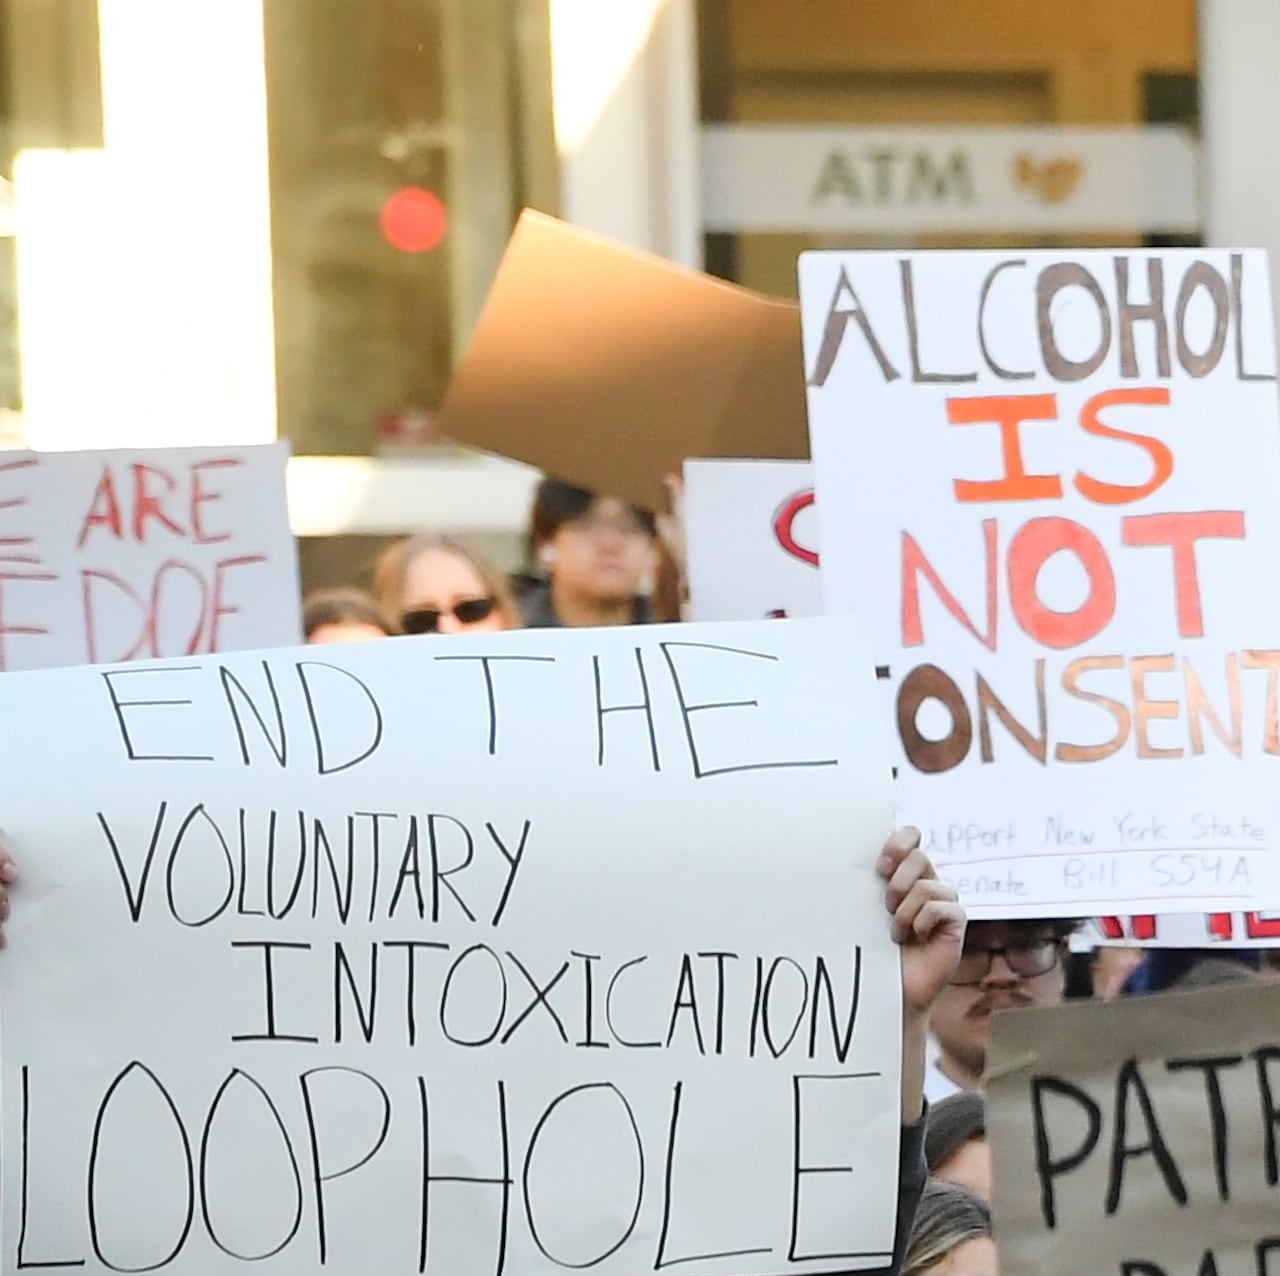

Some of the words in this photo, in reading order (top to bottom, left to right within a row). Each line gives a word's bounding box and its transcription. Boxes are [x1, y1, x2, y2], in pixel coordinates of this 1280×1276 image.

[806, 146, 978, 206] ATM
[806, 252, 1278, 387] ALCOHOL
[76, 458, 243, 550] ARE
[946, 387, 1174, 505] IS
[901, 510, 1246, 653] NOT
[102, 659, 383, 775] END
[434, 642, 839, 778] THE
[96, 801, 531, 927] VOLUNTARY
[924, 820, 1016, 856] upport
[1045, 815, 1097, 848] New
[1111, 811, 1168, 843] York
[1191, 809, 1268, 843] State
[1063, 856, 1119, 891] Bill
[230, 940, 864, 1063] INTOXICATION
